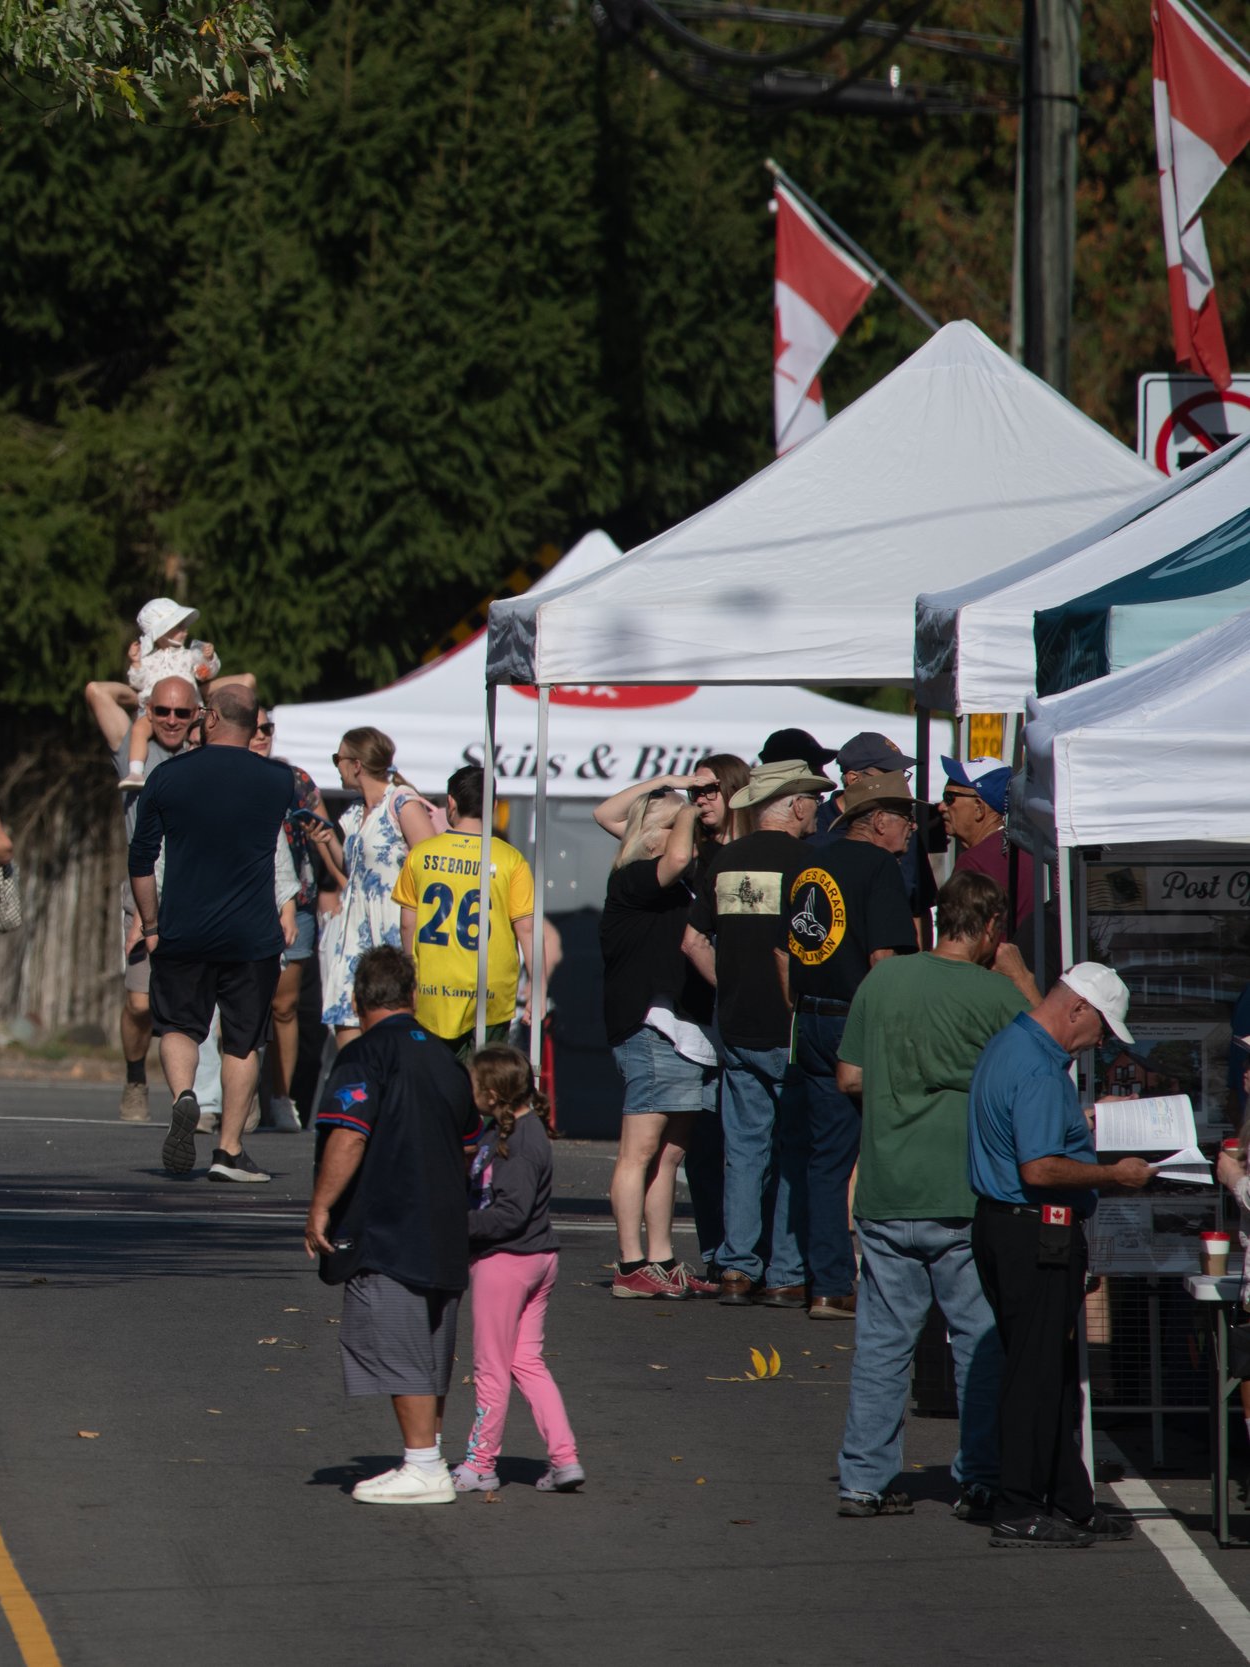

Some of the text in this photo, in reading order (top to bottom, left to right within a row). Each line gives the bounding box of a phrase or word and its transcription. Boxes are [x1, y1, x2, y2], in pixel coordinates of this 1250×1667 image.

[576, 743, 619, 779] &
[819, 873, 845, 928] GARAGE
[1161, 871, 1220, 899] Post
[418, 882, 492, 951] 26
[442, 985, 495, 999] Kampla
